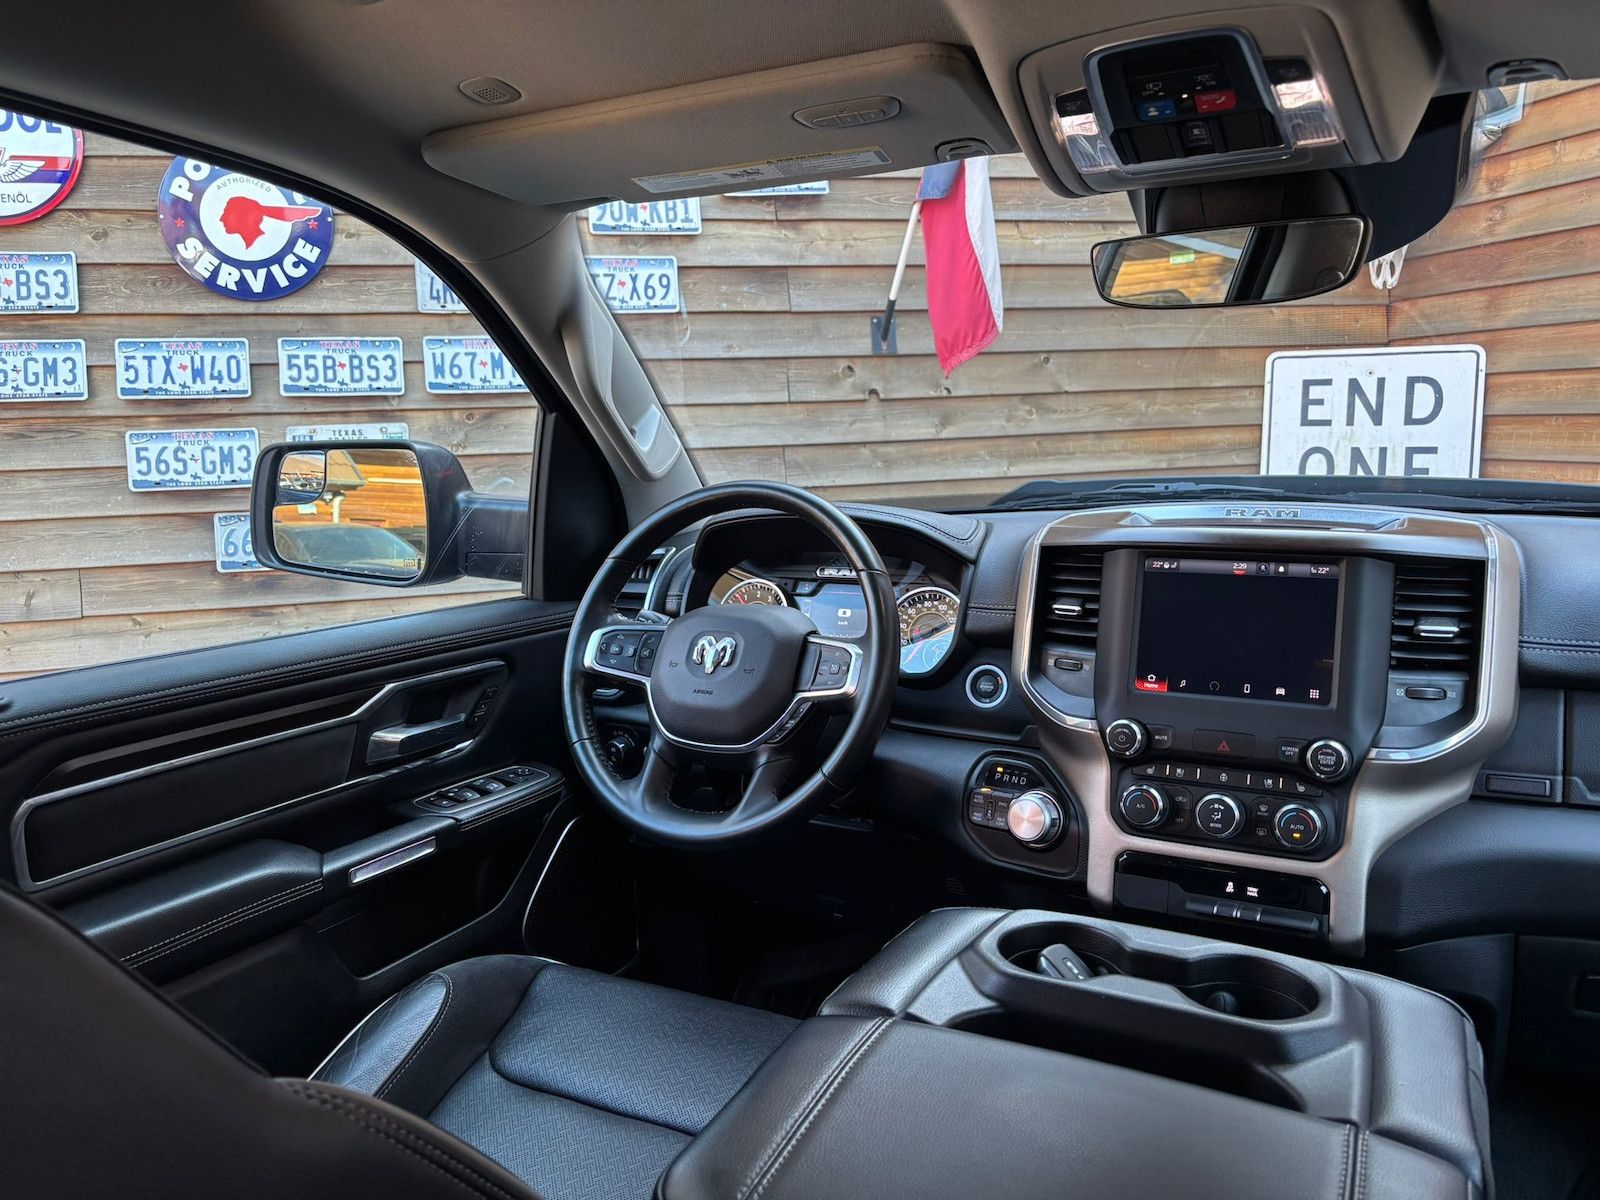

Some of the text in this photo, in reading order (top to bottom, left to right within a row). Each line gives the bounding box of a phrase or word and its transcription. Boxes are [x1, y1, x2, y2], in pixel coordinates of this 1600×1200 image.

[216, 176, 272, 193] AUTHORIZED
[176, 236, 322, 294] SERVICE
[15, 269, 70, 301] BS3
[629, 273, 671, 302] X69
[0, 342, 40, 351] EXAS
[463, 339, 500, 350] TEXA
[23, 356, 78, 387] GM3
[123, 354, 242, 385] 5TX W40
[286, 353, 398, 384] 55B BS3
[431, 351, 478, 380] W67
[1300, 375, 1444, 427] END
[172, 431, 215, 440] TEXAS
[176, 439, 210, 447] TRUCK
[332, 428, 364, 437] TEXAS
[135, 444, 252, 476] 56S GM3
[1224, 507, 1301, 519] RAM
[907, 607, 916, 615] 60
[1289, 823, 1305, 831] AUTO
